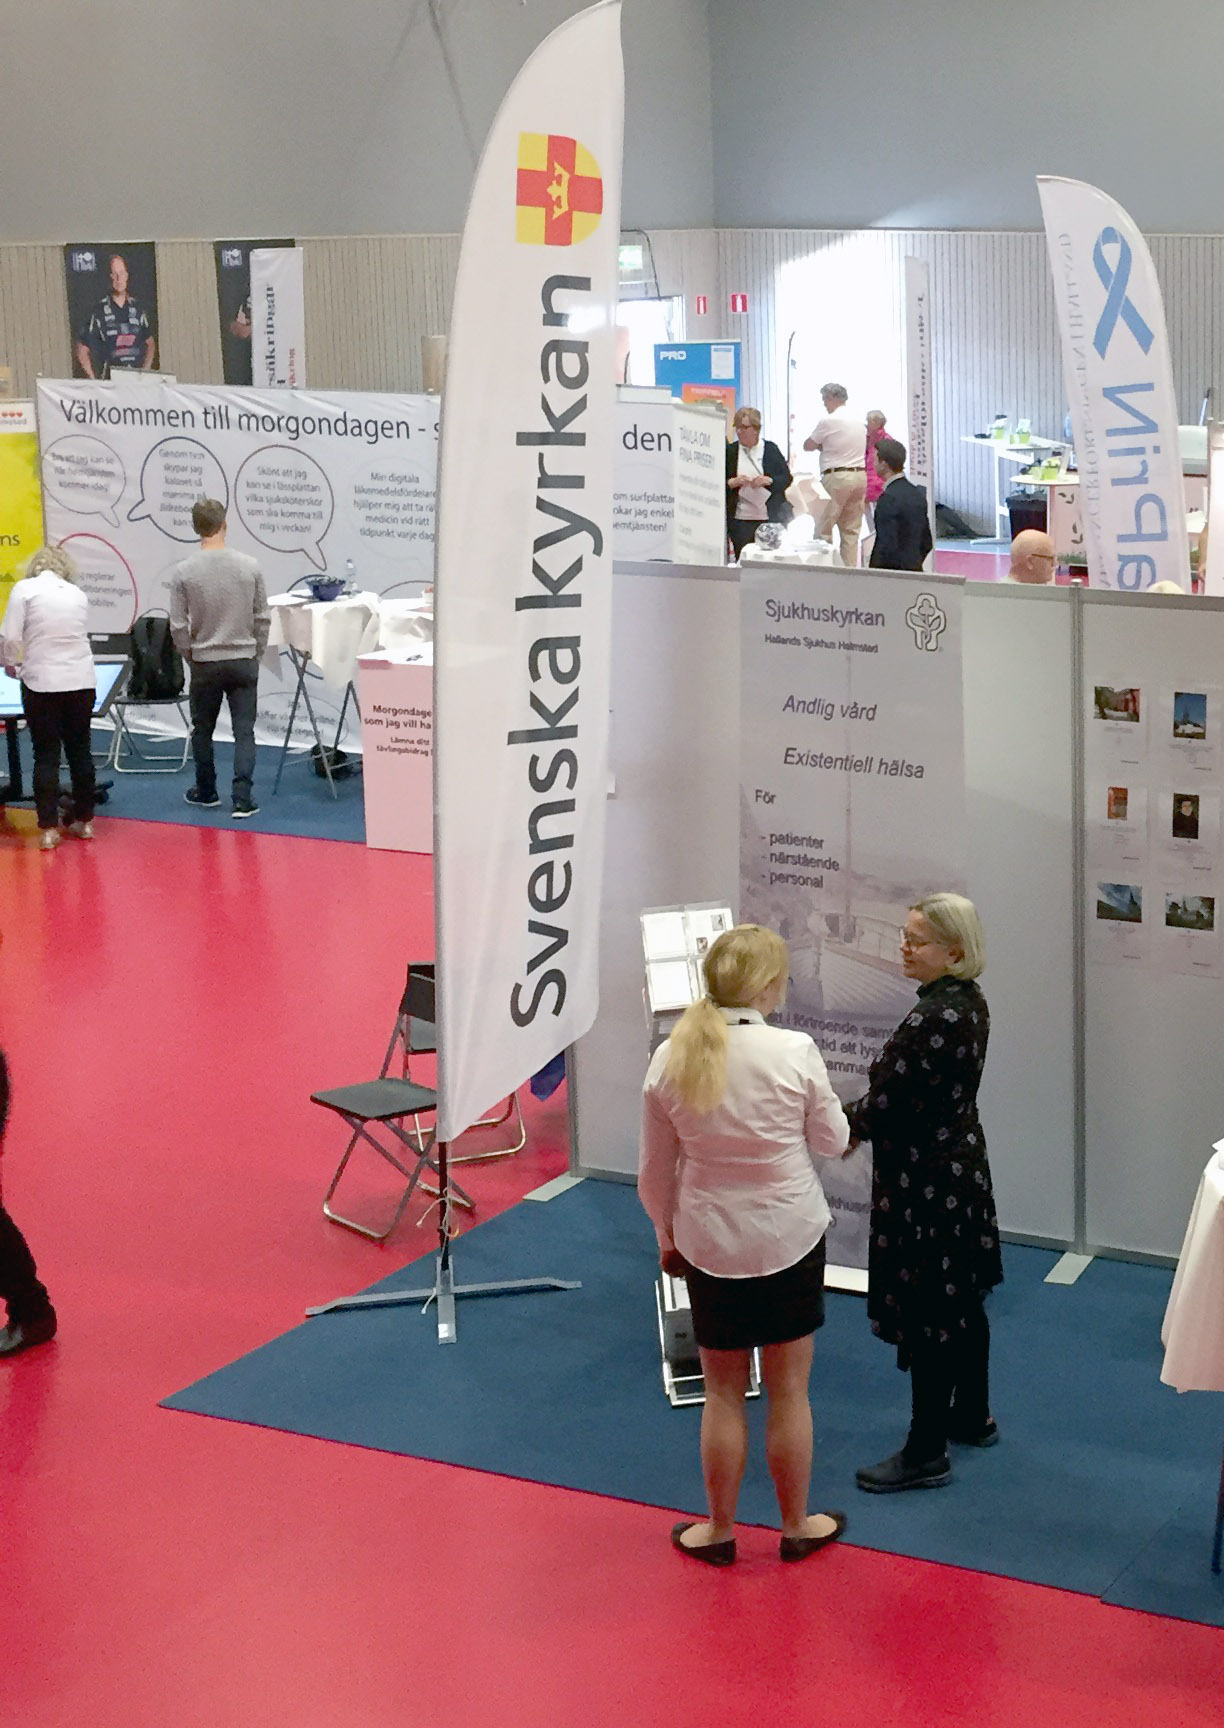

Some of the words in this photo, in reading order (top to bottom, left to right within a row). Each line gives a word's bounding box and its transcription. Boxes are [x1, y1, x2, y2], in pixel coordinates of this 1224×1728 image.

[660, 350, 687, 361] PRO
[60, 399, 195, 428] Välkommen
[202, 405, 230, 430] till
[238, 411, 410, 445] morgondagen
[515, 274, 603, 612] kyrkan
[622, 424, 672, 452] den
[281, 468, 293, 478] att
[294, 469, 308, 481] jag
[370, 472, 387, 481] Min
[388, 473, 420, 485] digitala
[245, 480, 261, 489] kan
[262, 482, 272, 490] se
[245, 493, 264, 503] vilka
[353, 498, 382, 511] hjälper
[384, 501, 400, 513] mig
[402, 502, 414, 512] att
[415, 503, 424, 512] ta
[246, 508, 264, 516] som
[265, 507, 279, 518] ska
[280, 508, 311, 520] komma
[312, 510, 324, 520] till
[365, 514, 399, 525] medicin
[400, 516, 413, 525] vid
[415, 516, 430, 526] rätt
[634, 507, 648, 519] jag
[259, 521, 275, 533] mig
[281, 522, 312, 534] veckan!
[612, 520, 668, 532] emtjänsten!
[359, 527, 395, 538] tidpunkt
[397, 530, 418, 542] varje
[418, 530, 435, 542] dag
[765, 598, 885, 628] Sjukhuskyrkan
[764, 633, 801, 646] Hallands
[803, 636, 836, 649] Sjukhus
[838, 641, 878, 654] Halmstad
[782, 695, 835, 721] Andlig
[840, 701, 878, 721] vård
[364, 717, 384, 726] som
[385, 717, 400, 729] jag
[402, 719, 418, 729] vill
[420, 720, 432, 729] ha
[390, 736, 415, 745] Lämna
[783, 747, 872, 774] Existentiell
[878, 757, 925, 779] hälsa
[755, 789, 776, 804] För
[507, 635, 582, 1028] Svenska
[769, 831, 824, 849] patienter
[769, 852, 840, 872] närstående
[769, 871, 824, 889] personal
[793, 1012, 858, 1035] förtroende
[840, 1042, 857, 1055] ett
